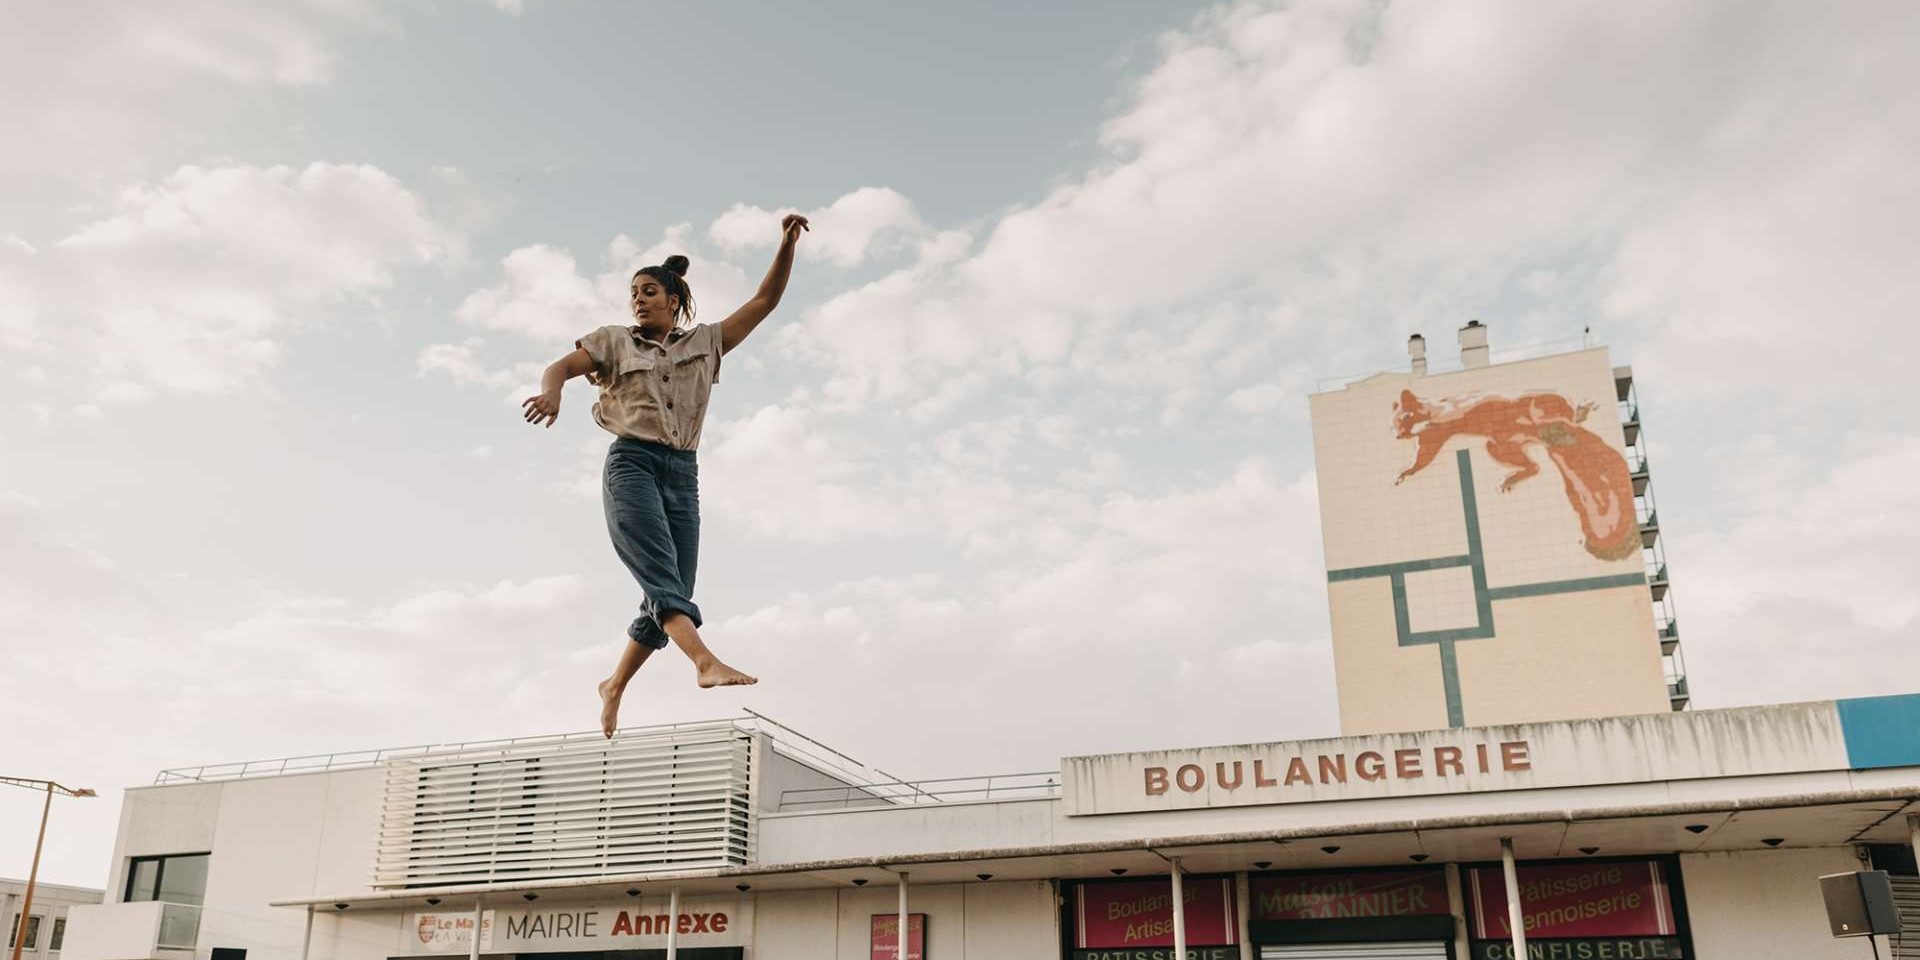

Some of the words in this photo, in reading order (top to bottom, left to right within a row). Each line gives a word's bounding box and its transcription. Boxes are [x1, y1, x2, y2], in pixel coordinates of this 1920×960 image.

[1143, 740, 1532, 796] BOULANGERIE
[1259, 878, 1357, 916] Maison
[1520, 866, 1622, 902] âtisserie
[1108, 887, 1200, 921] Boulaner
[1499, 890, 1641, 935] Vennoiserie
[438, 918, 453, 930] Le
[455, 917, 490, 929] Mas
[455, 930, 488, 942] VILE
[506, 912, 599, 940] MAIRIE
[611, 911, 729, 936] Annexe
[1124, 918, 1175, 943] Artisa
